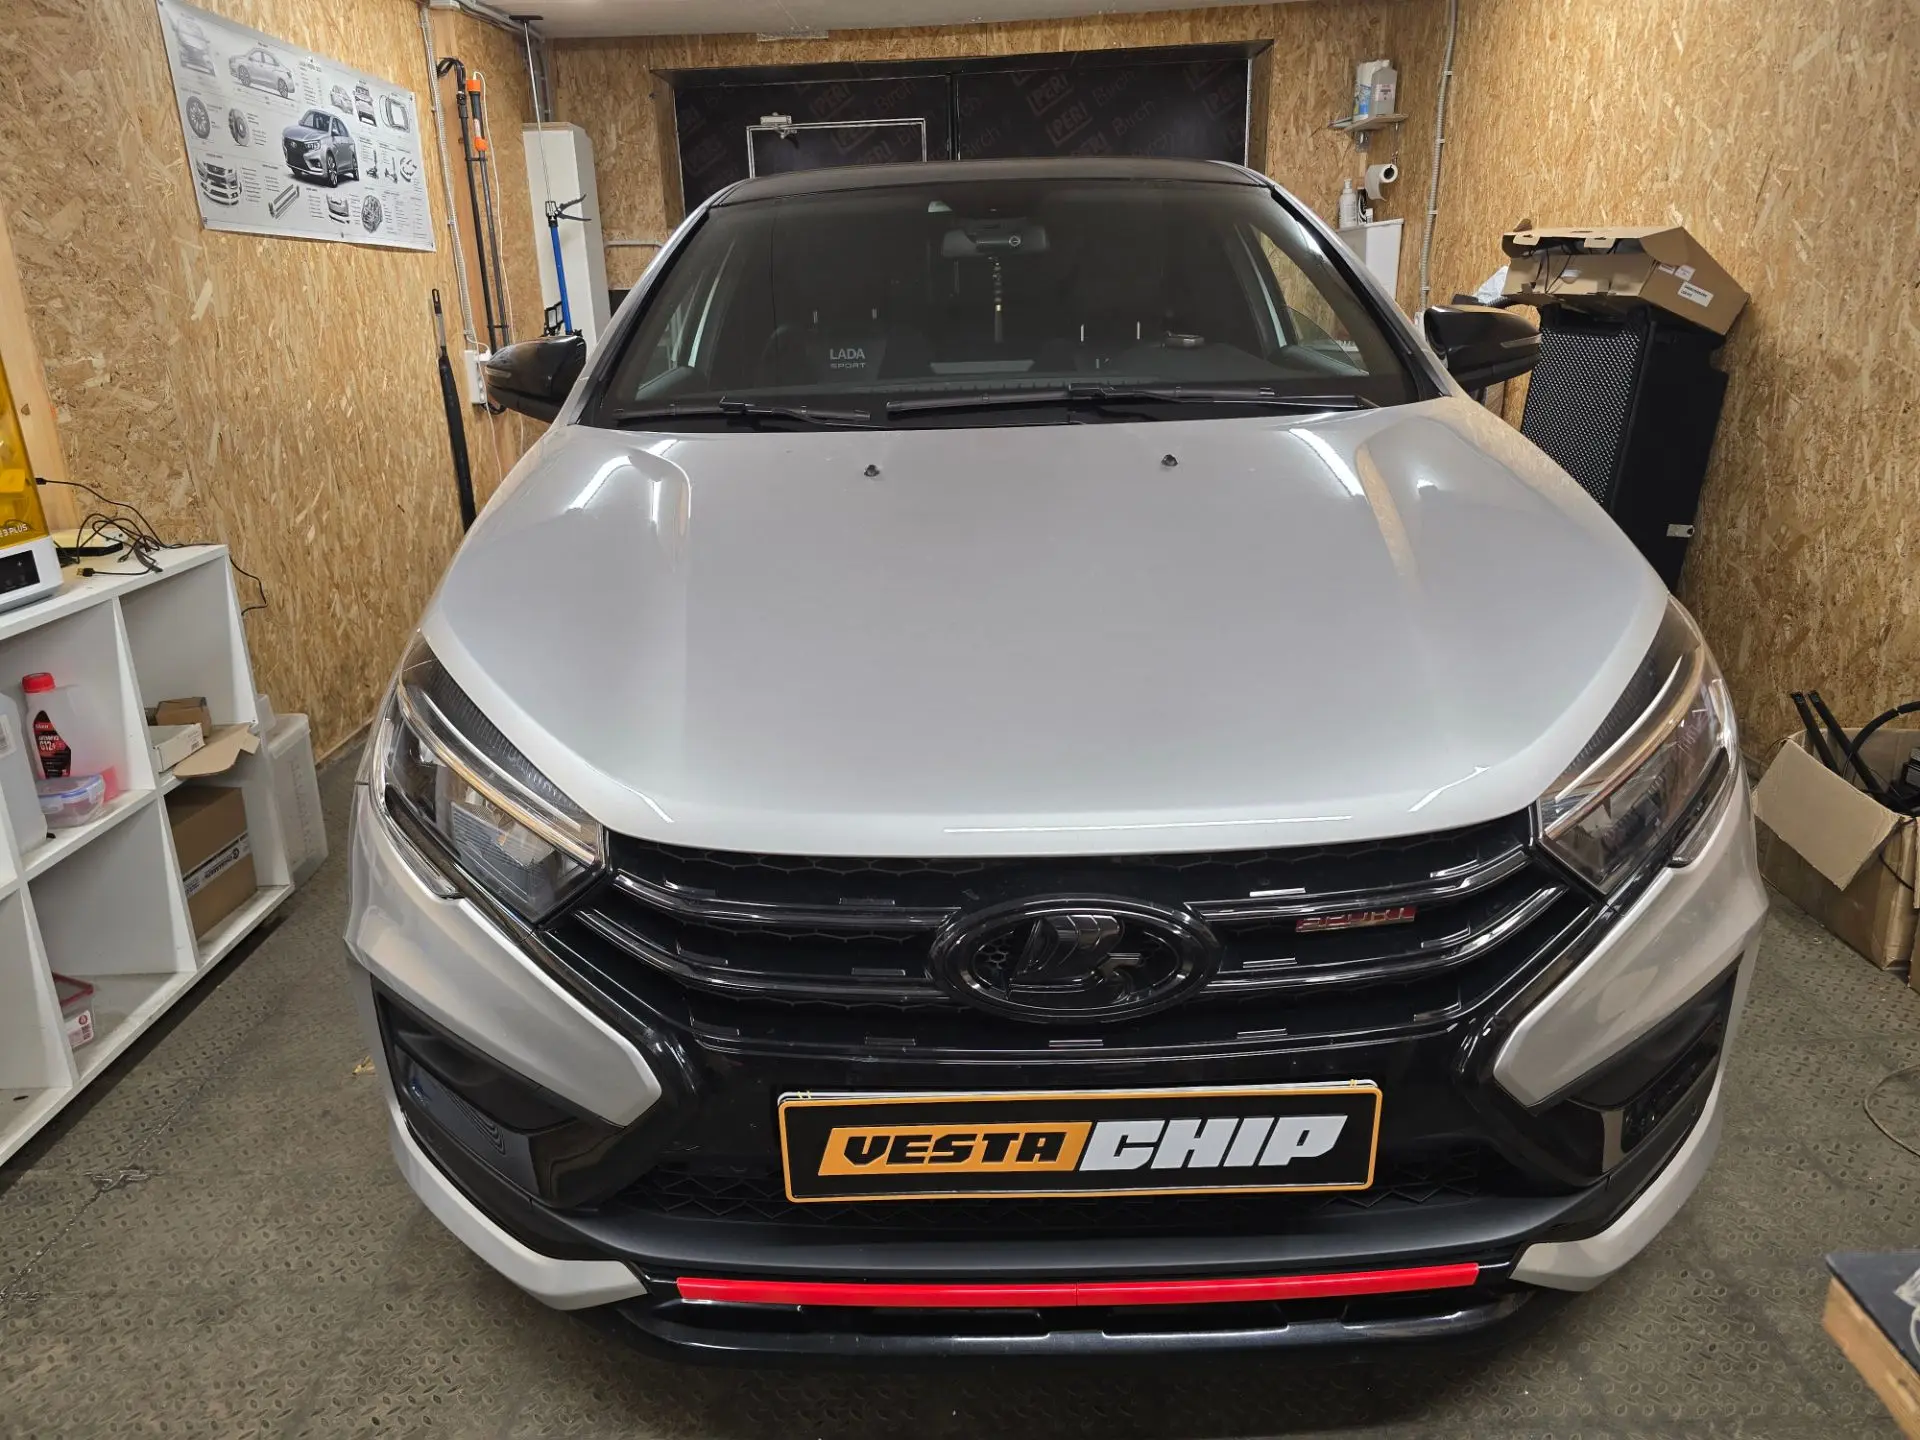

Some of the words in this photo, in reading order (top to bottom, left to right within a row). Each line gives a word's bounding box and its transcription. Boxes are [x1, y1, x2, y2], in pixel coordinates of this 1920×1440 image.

[1031, 74, 1069, 107] PERI
[1052, 100, 1089, 137] PERI
[1112, 99, 1157, 137] Birch
[830, 348, 866, 360] LADA
[8, 523, 28, 535] PLUS
[844, 1131, 1068, 1168] VESTA
[1079, 1115, 1348, 1171] CHIP
